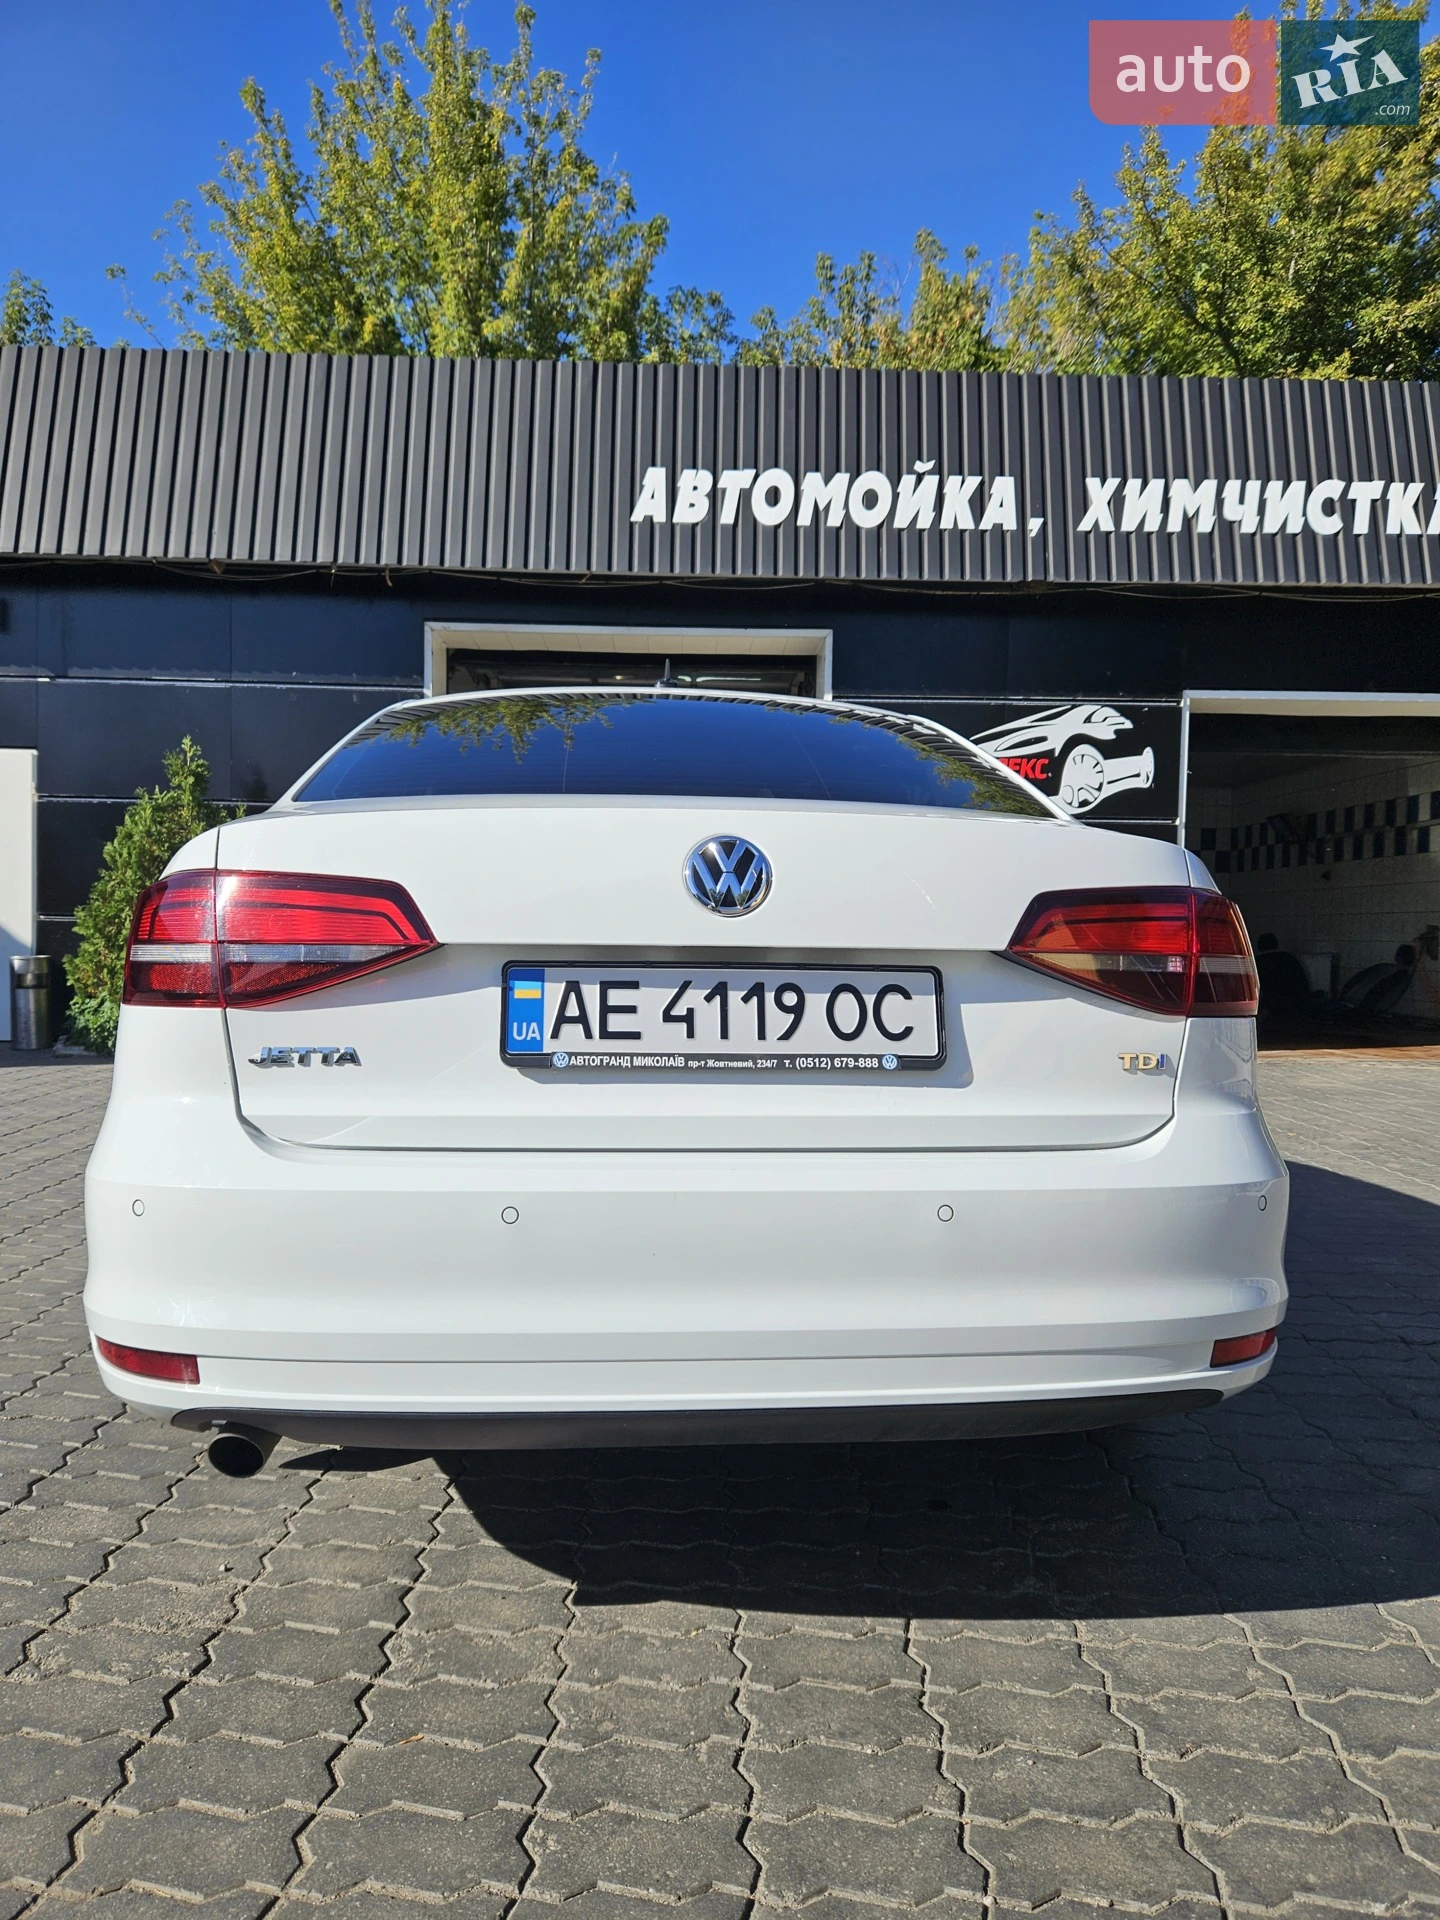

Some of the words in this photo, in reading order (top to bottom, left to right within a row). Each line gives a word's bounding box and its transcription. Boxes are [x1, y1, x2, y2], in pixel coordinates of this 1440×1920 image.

[629, 459, 1045, 538] АВТОМОЙКА,
[998, 757, 1049, 780] ЕКС
[549, 980, 642, 1041] AE
[662, 979, 807, 1042] 4119
[825, 982, 915, 1042] OC
[512, 1021, 541, 1041] UA
[248, 1046, 362, 1069] JETTA
[569, 1055, 631, 1068] АВТОГРАНД
[633, 1054, 685, 1068] МИКОЛАЇВ
[687, 1059, 706, 1069] пр-т
[706, 1059, 756, 1070] Жовтневий,
[756, 1059, 778, 1069] 234/7
[795, 1057, 832, 1071] (0512)
[834, 1057, 879, 1069] 679-888
[1117, 1052, 1168, 1071] TDI
